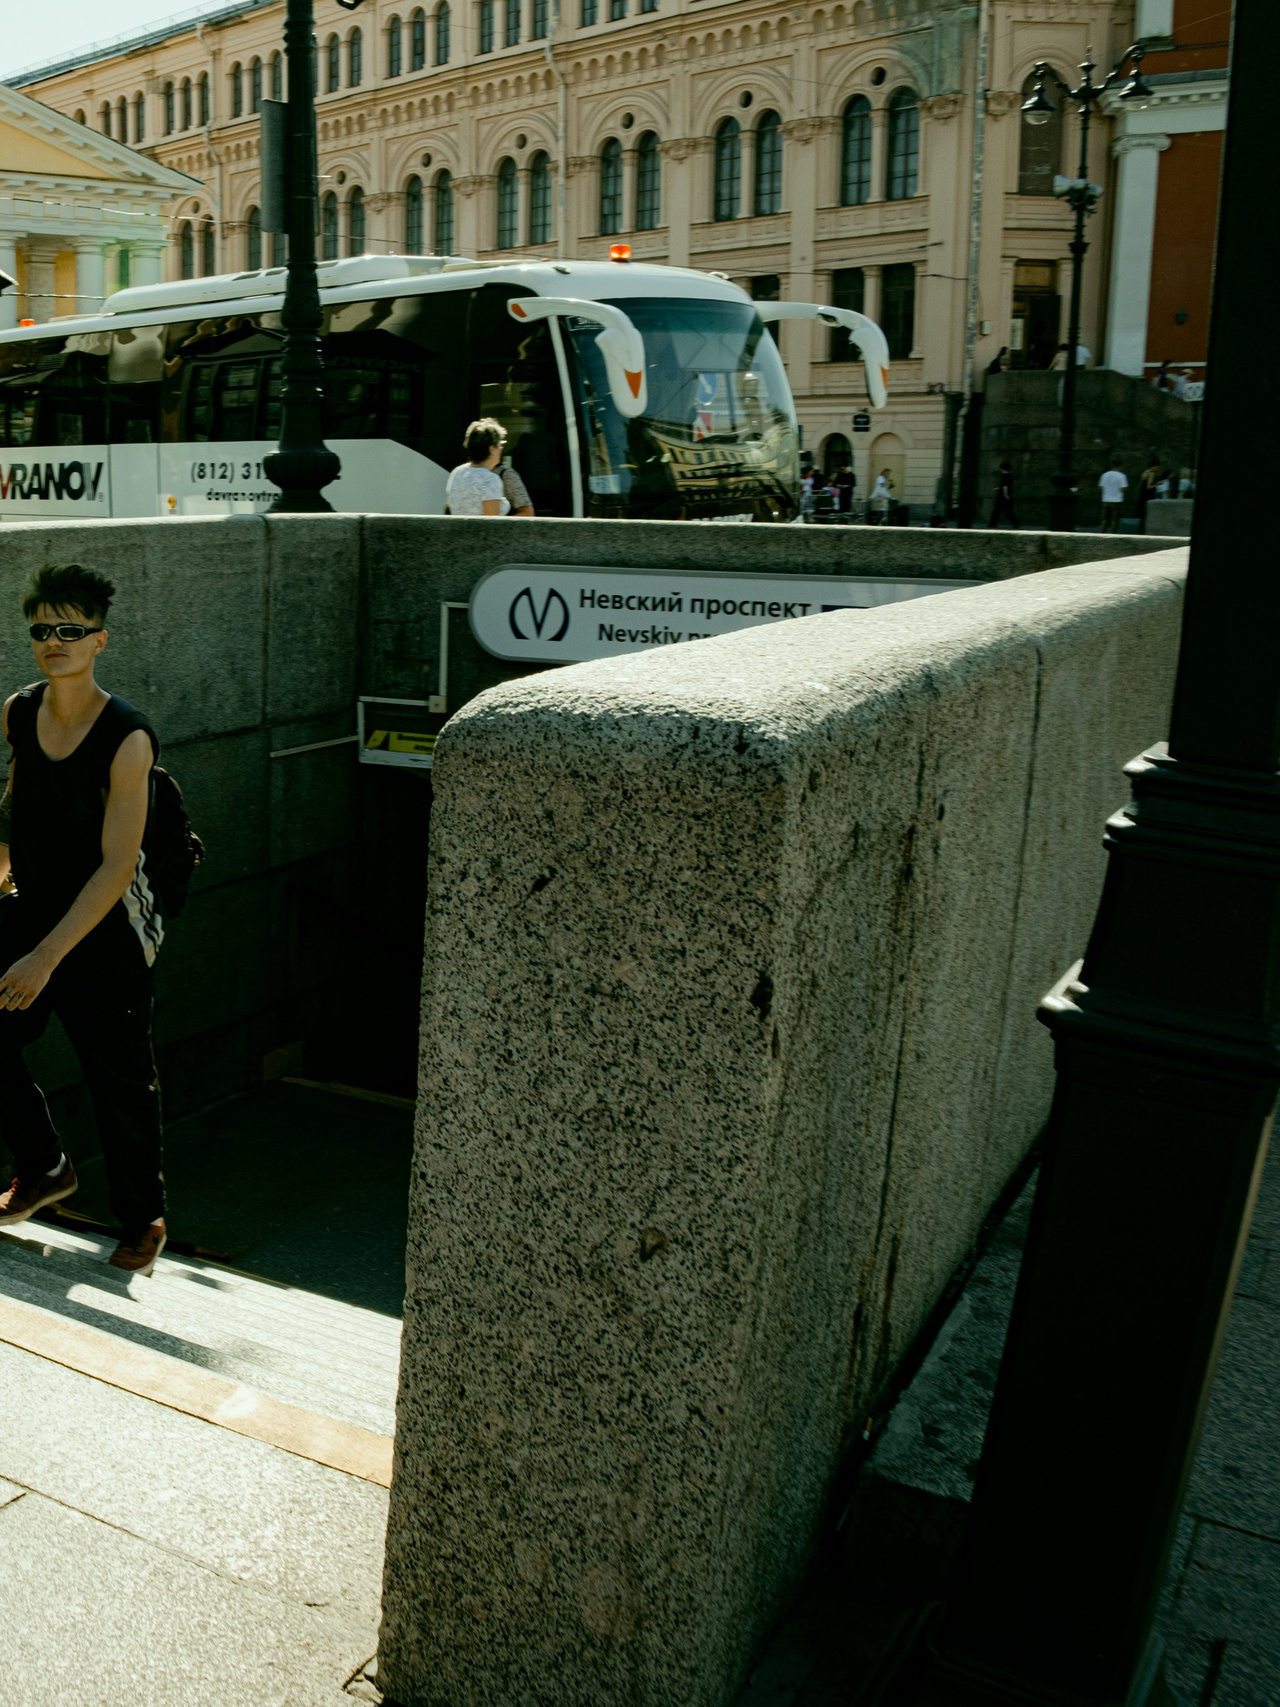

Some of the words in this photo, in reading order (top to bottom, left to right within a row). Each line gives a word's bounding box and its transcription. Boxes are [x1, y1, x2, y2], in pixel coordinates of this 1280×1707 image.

[191, 462, 234, 483] (812)
[206, 488, 282, 502] davranovtra
[580, 588, 683, 613] Невский
[691, 597, 811, 619] проспект
